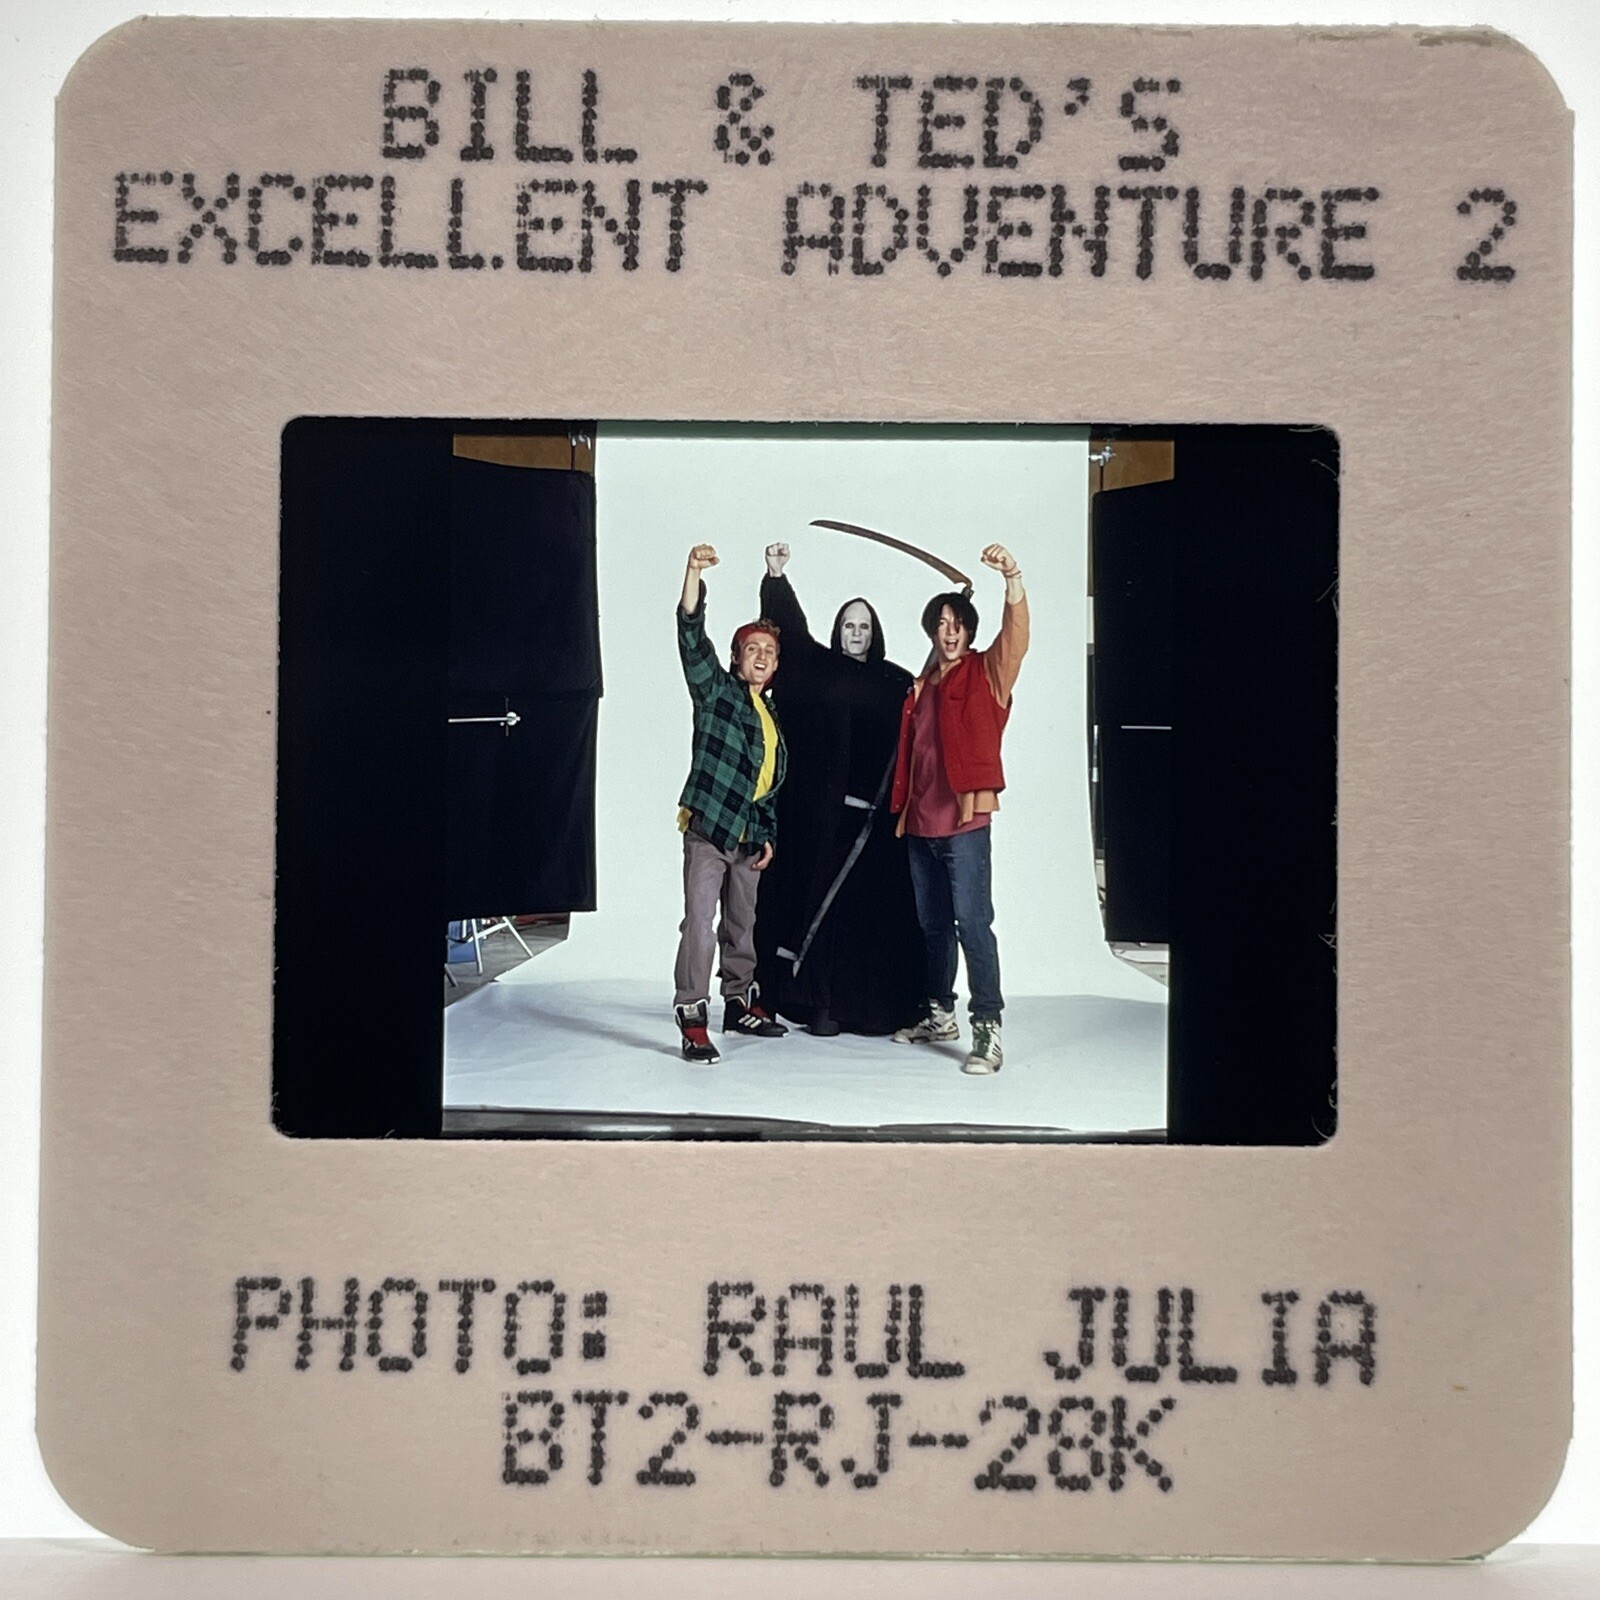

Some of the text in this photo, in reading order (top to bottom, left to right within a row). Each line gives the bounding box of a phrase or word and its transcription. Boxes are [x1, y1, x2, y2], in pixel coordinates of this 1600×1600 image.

[381, 67, 1181, 172] BILL & TED'S
[112, 171, 1518, 283] EXCELLENT ADVENTURE 2
[230, 1276, 1378, 1387] PHOTO: RAUL JULIA
[502, 1390, 1177, 1493] BT2-RJ-28K
